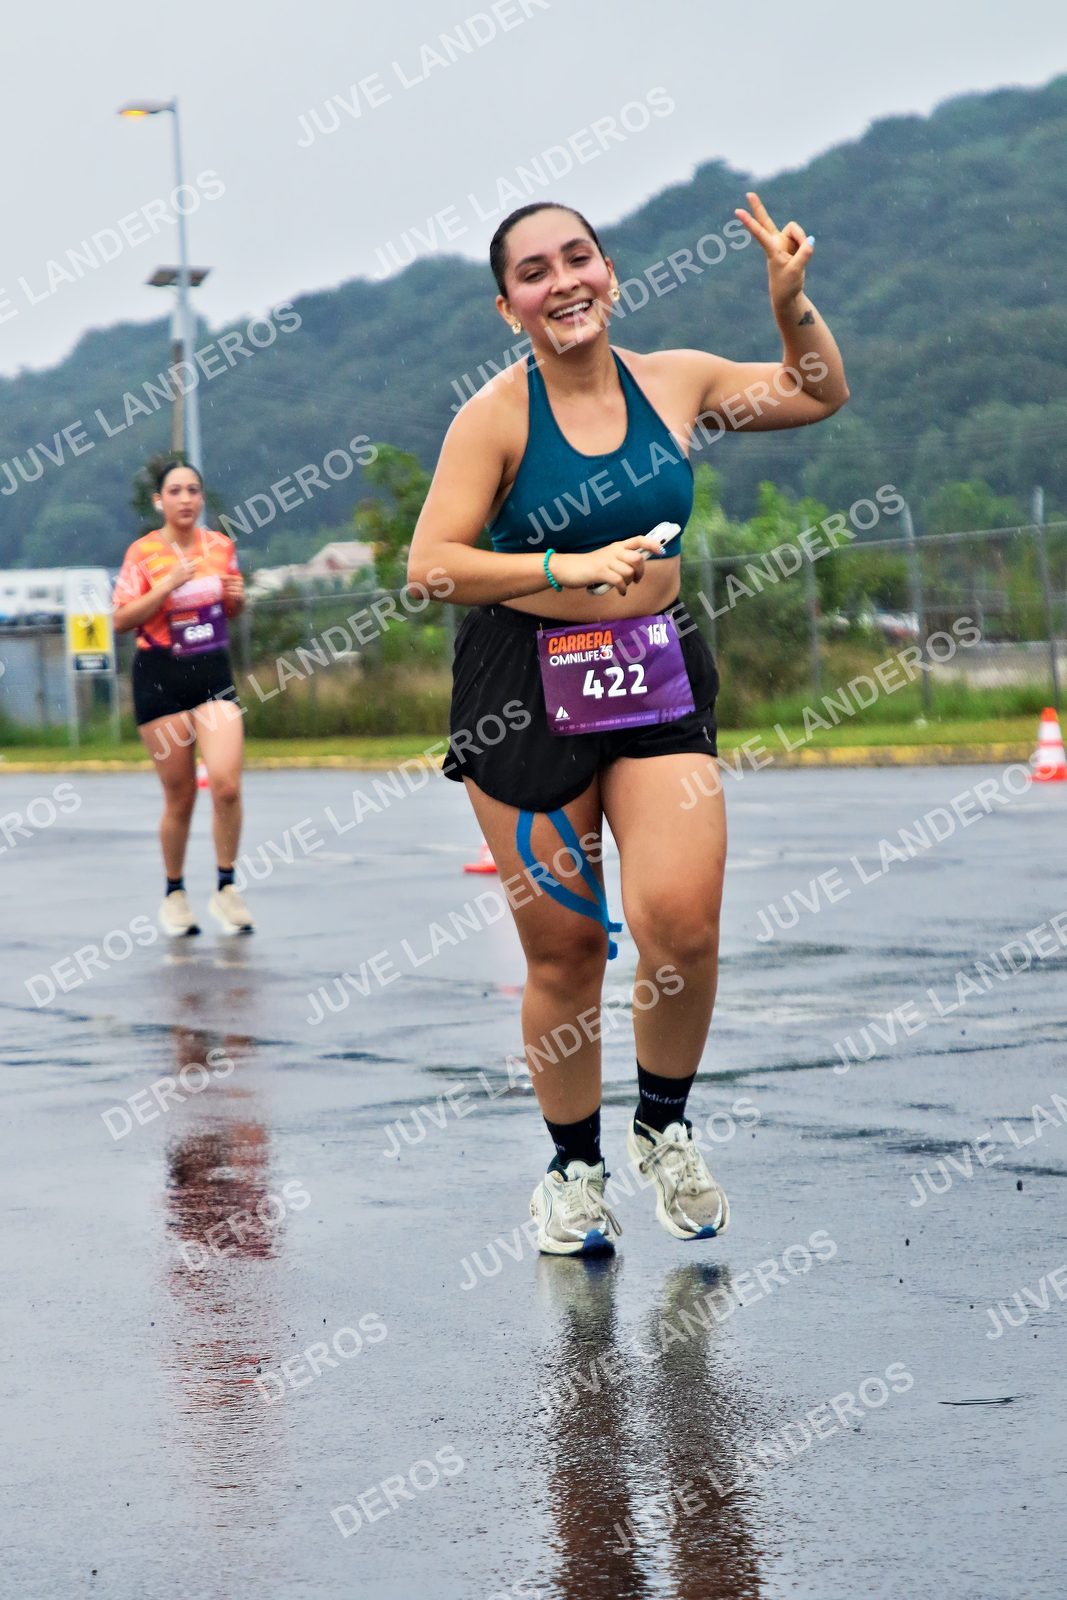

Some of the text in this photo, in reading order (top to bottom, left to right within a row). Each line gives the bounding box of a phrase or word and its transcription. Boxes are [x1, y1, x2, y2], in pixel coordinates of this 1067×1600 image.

[548, 628, 613, 655] CARRERA
[647, 623, 669, 646] 15K
[549, 649, 600, 667] OMNILIFE
[582, 663, 648, 699] 422
